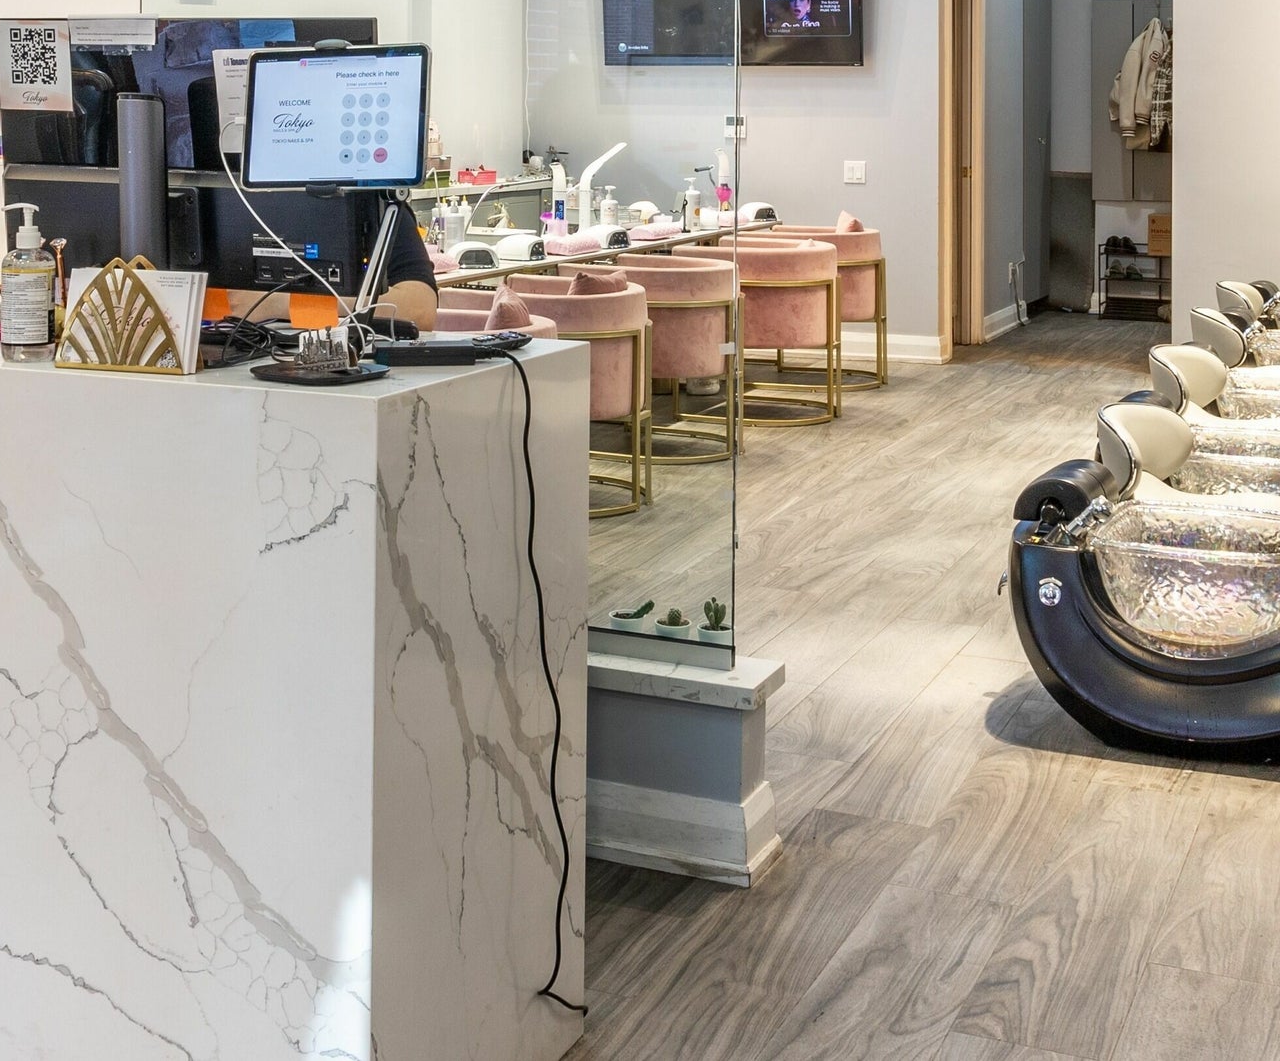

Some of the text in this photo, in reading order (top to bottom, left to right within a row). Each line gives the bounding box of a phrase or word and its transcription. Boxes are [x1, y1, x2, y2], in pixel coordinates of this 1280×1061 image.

[335, 71, 357, 79] Please
[358, 70, 377, 78] check
[385, 69, 400, 77] here
[22, 91, 48, 106] Tokyo
[278, 99, 312, 107] WELCOME
[273, 112, 315, 134] Tokyo
